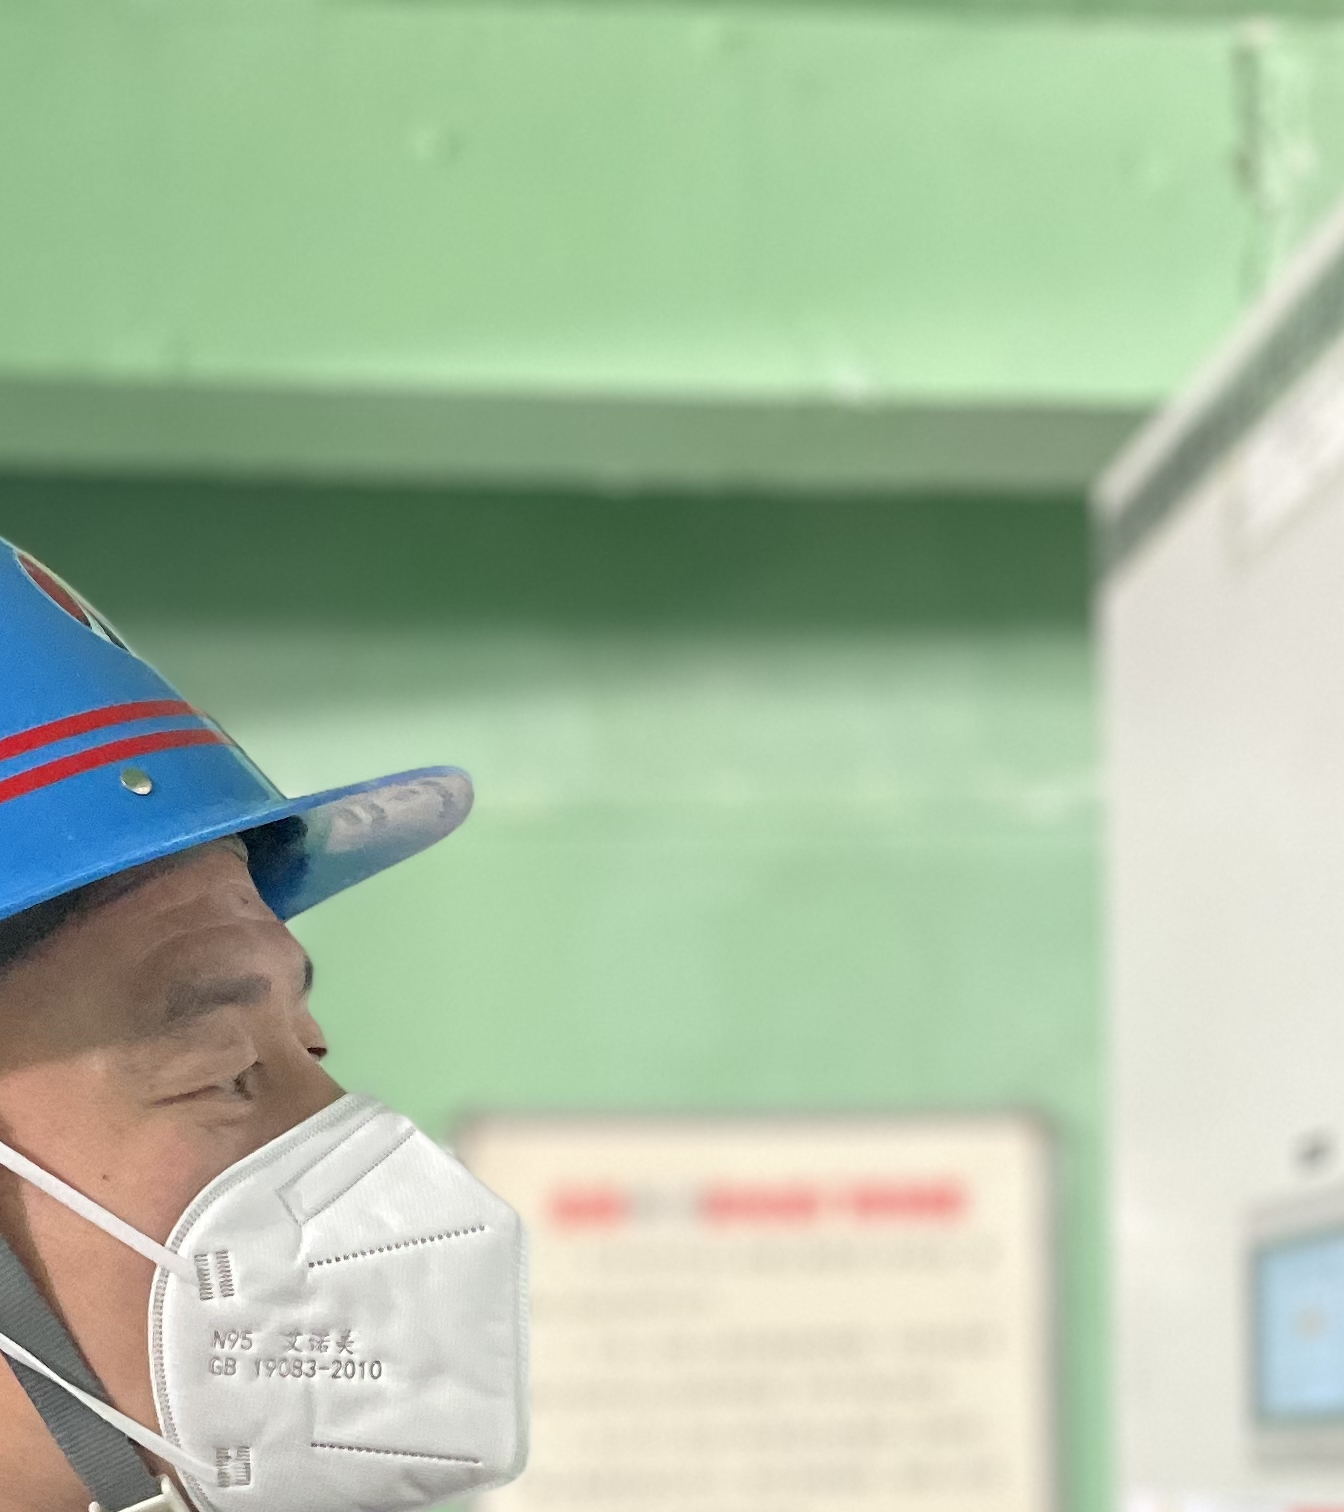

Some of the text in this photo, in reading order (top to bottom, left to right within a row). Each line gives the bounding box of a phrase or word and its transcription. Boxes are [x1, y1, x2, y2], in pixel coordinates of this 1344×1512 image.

[212, 1329, 253, 1351] N95
[209, 1356, 383, 1380] GB 19083-2010
